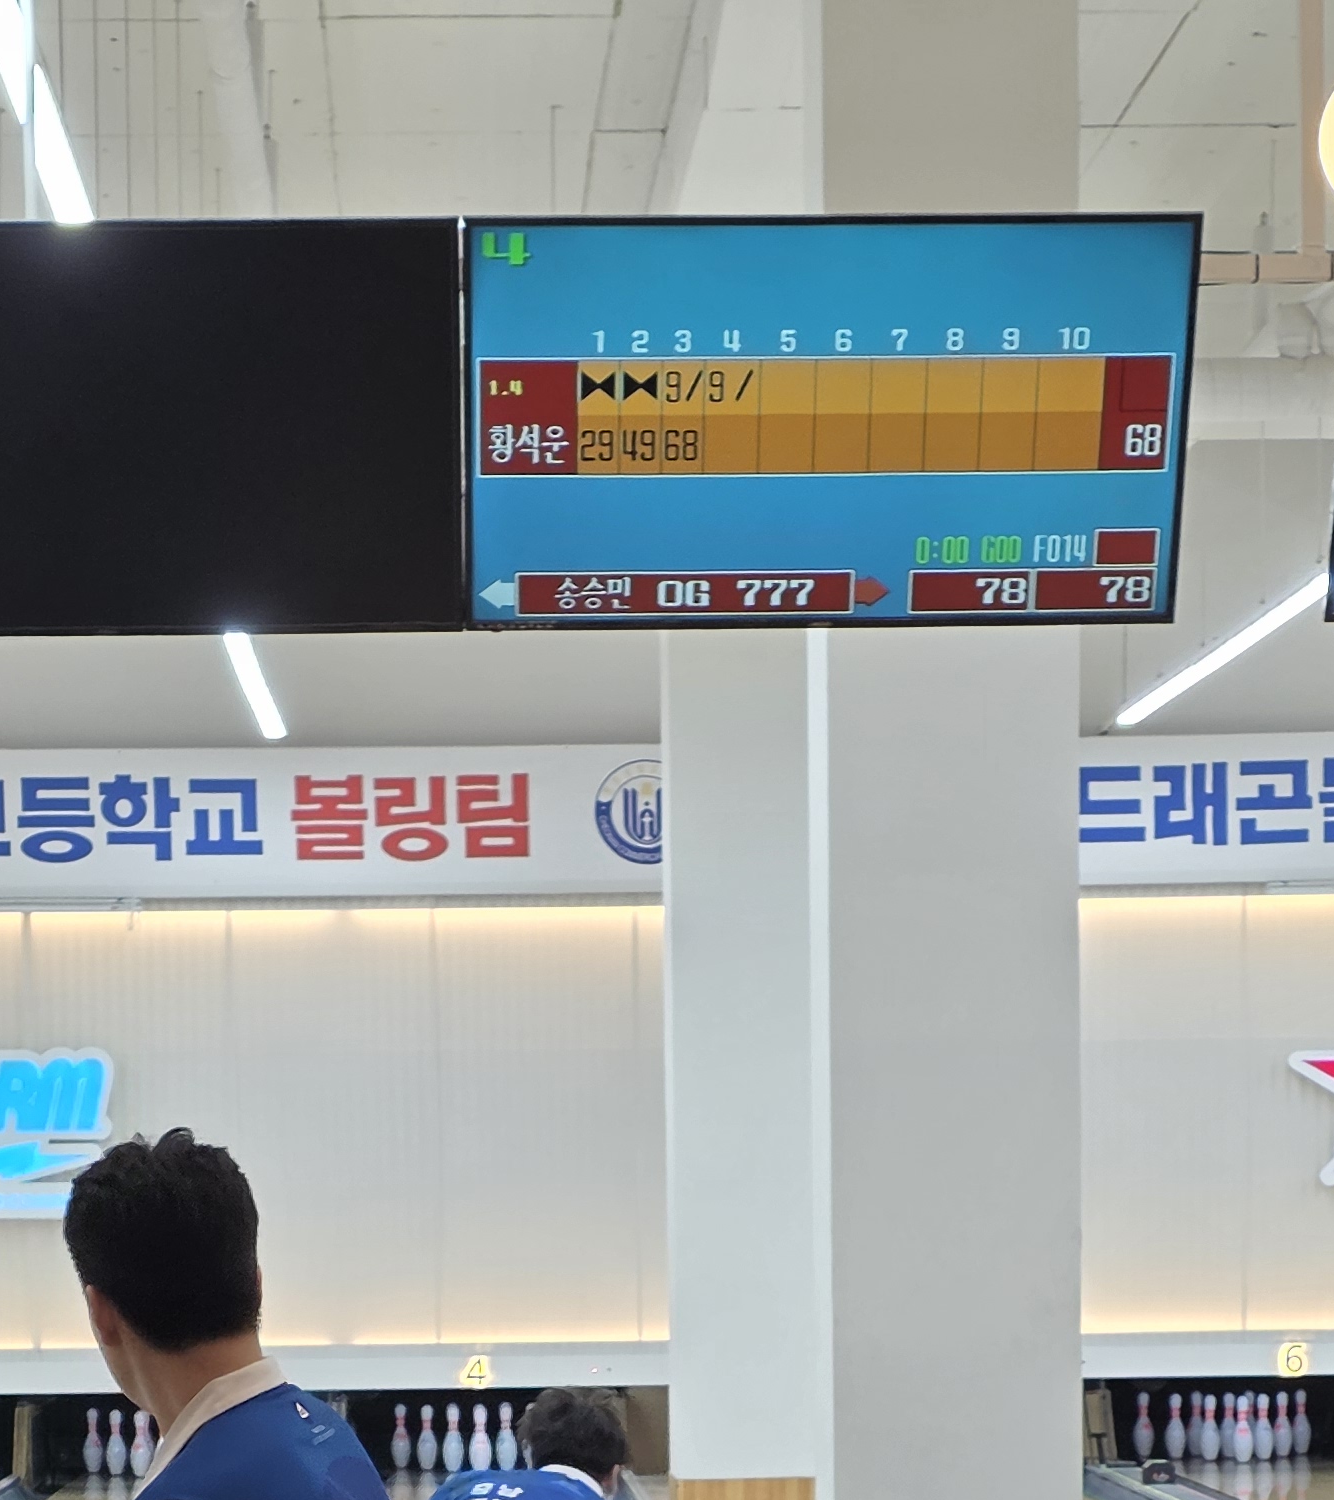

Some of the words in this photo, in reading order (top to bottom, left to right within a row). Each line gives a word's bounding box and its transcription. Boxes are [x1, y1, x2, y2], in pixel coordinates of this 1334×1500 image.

[481, 232, 532, 266] 4
[591, 330, 606, 353] 1
[630, 329, 651, 354] 2
[673, 329, 693, 353] 3
[722, 329, 743, 353] 4
[779, 329, 798, 353] 5
[834, 329, 854, 352] 6
[890, 328, 910, 352] 7
[945, 328, 965, 351] 8
[1001, 328, 1021, 351] 9
[1057, 327, 1092, 351] 10
[488, 422, 571, 465] 황석운
[579, 429, 615, 462] 29
[621, 429, 657, 462] 49
[664, 429, 700, 462] 68
[1124, 423, 1163, 458] 68
[554, 576, 632, 610] 송승민
[735, 578, 816, 607] 777
[975, 576, 1028, 605] 78
[1098, 575, 1152, 604] 78
[290, 771, 531, 863] 볼링팀
[466, 1358, 486, 1386] 4
[1284, 1344, 1304, 1373] 6
